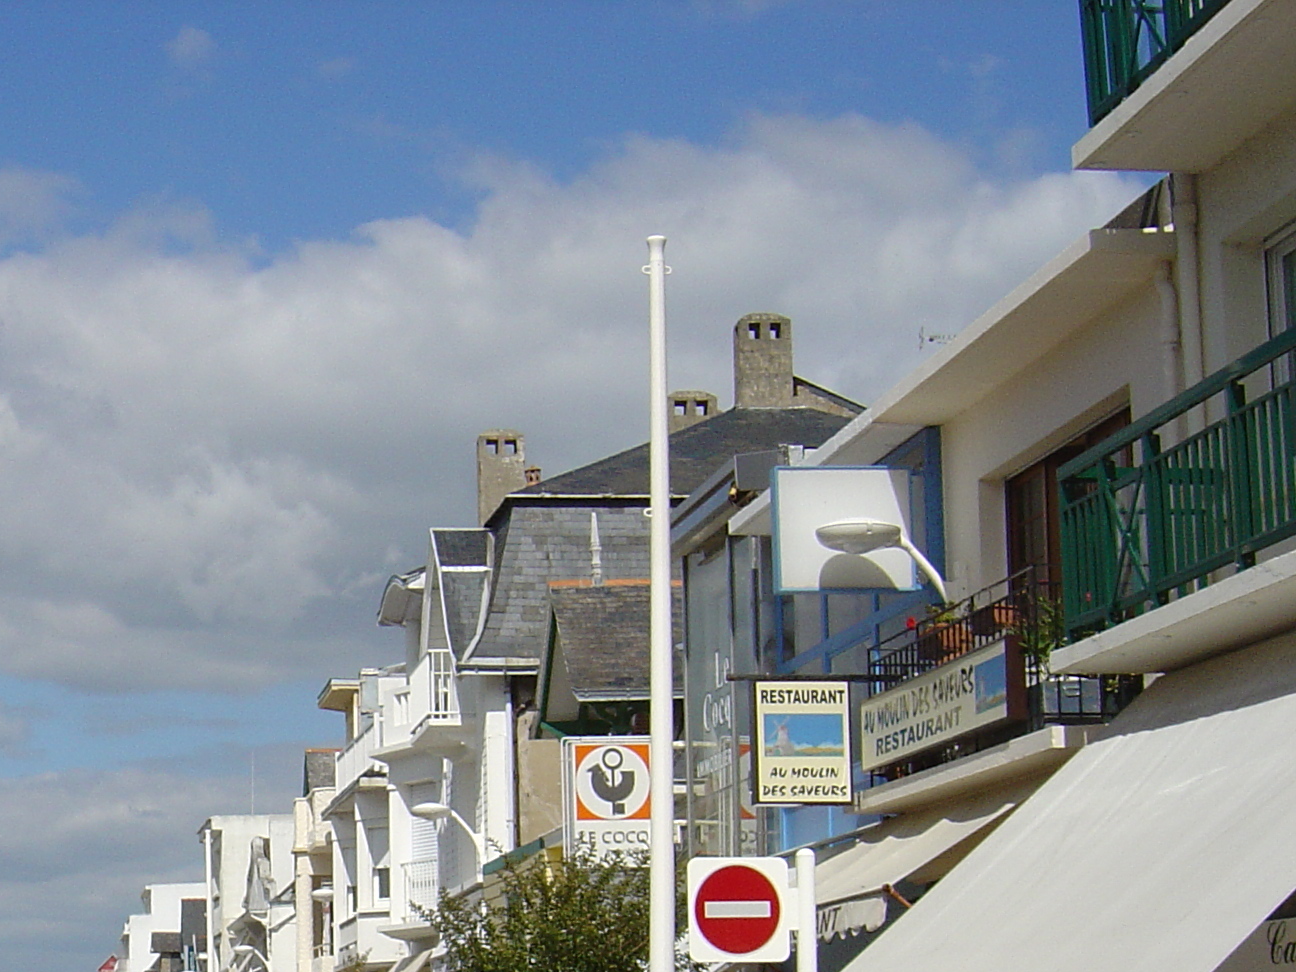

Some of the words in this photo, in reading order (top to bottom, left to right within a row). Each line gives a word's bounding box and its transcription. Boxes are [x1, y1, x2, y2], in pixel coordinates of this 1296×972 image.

[760, 689, 846, 706] RESTAURANT
[863, 711, 876, 734] AU
[877, 697, 910, 731] MOULIN
[912, 686, 930, 714] DES
[933, 664, 974, 708] SAVEURS
[703, 693, 732, 731] Cocq
[875, 705, 962, 757] RESTAURANT
[769, 767, 787, 779] AU
[791, 766, 840, 779] MOULIN
[762, 785, 787, 797] DES
[790, 784, 848, 797] SAVEURS
[602, 830, 649, 845] COCQ
